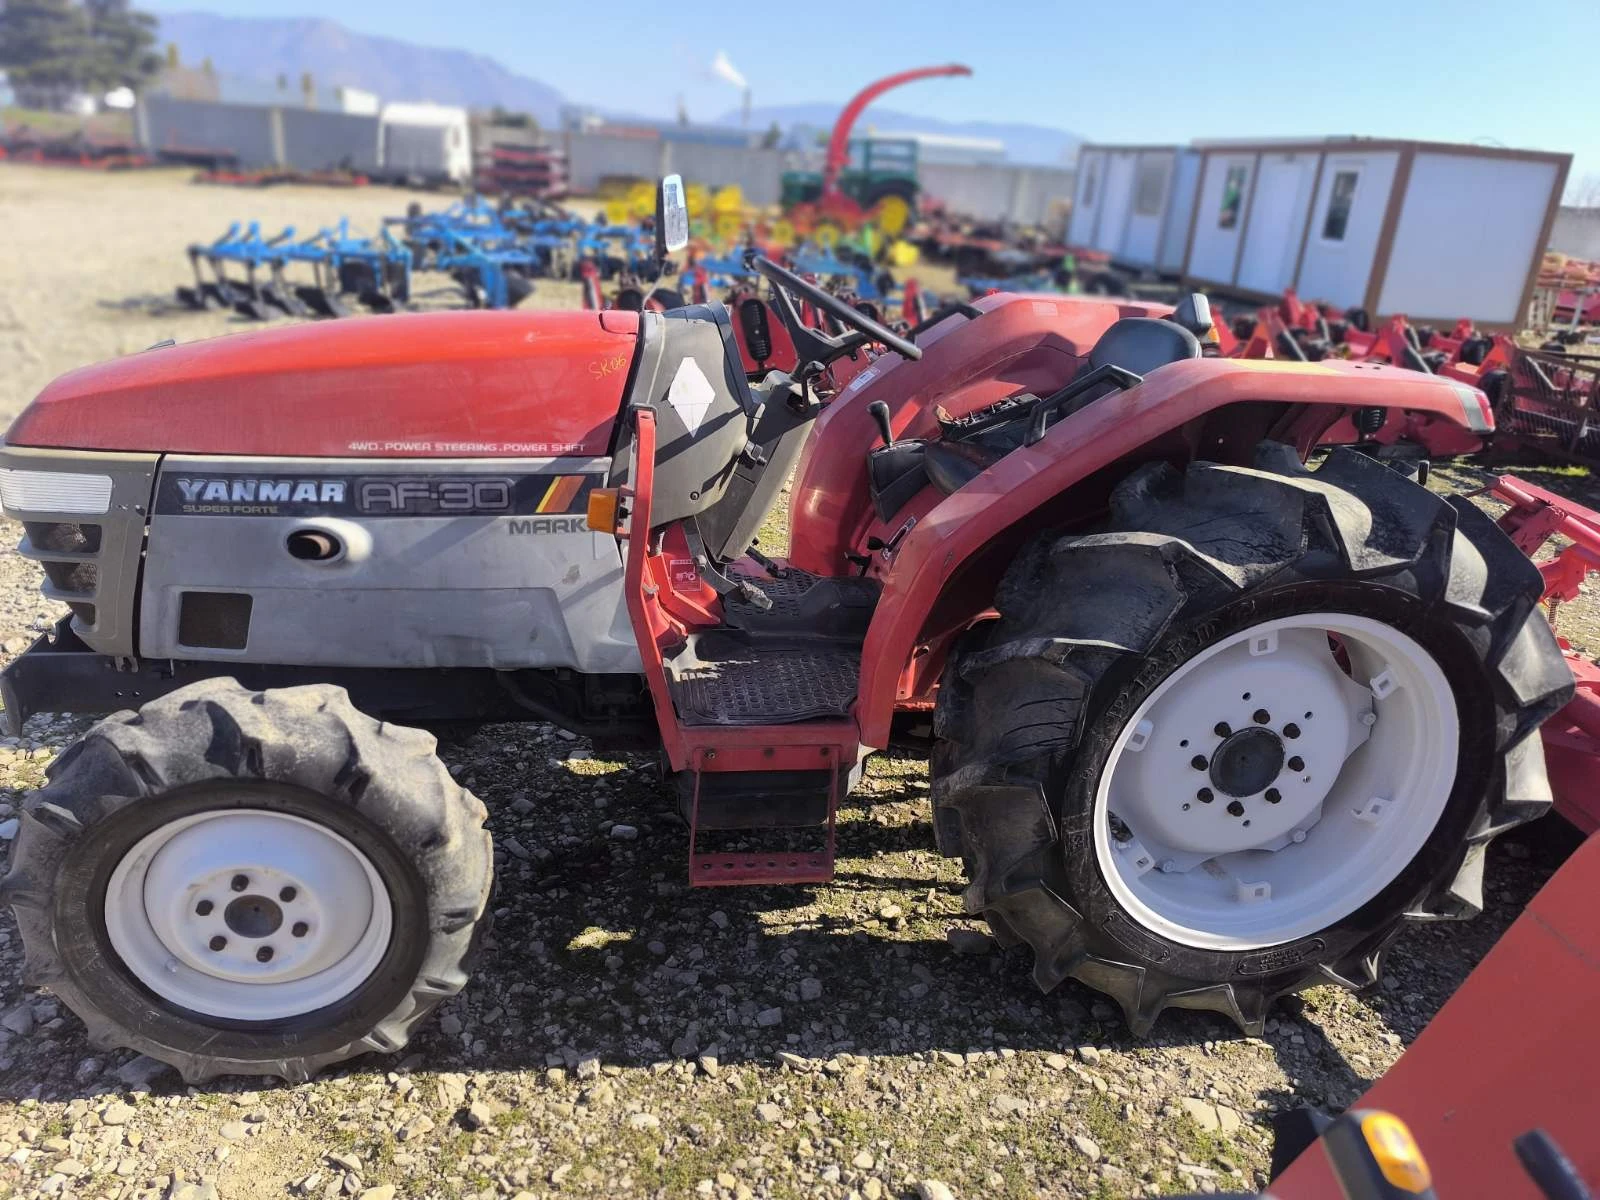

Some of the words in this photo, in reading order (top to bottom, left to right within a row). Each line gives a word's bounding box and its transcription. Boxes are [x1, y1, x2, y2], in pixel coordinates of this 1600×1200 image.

[551, 443, 585, 452] SHIFT
[177, 478, 347, 502] YANMAR
[183, 504, 231, 513] SUPER
[233, 505, 278, 514] FORTE
[508, 519, 587, 534] MARK
